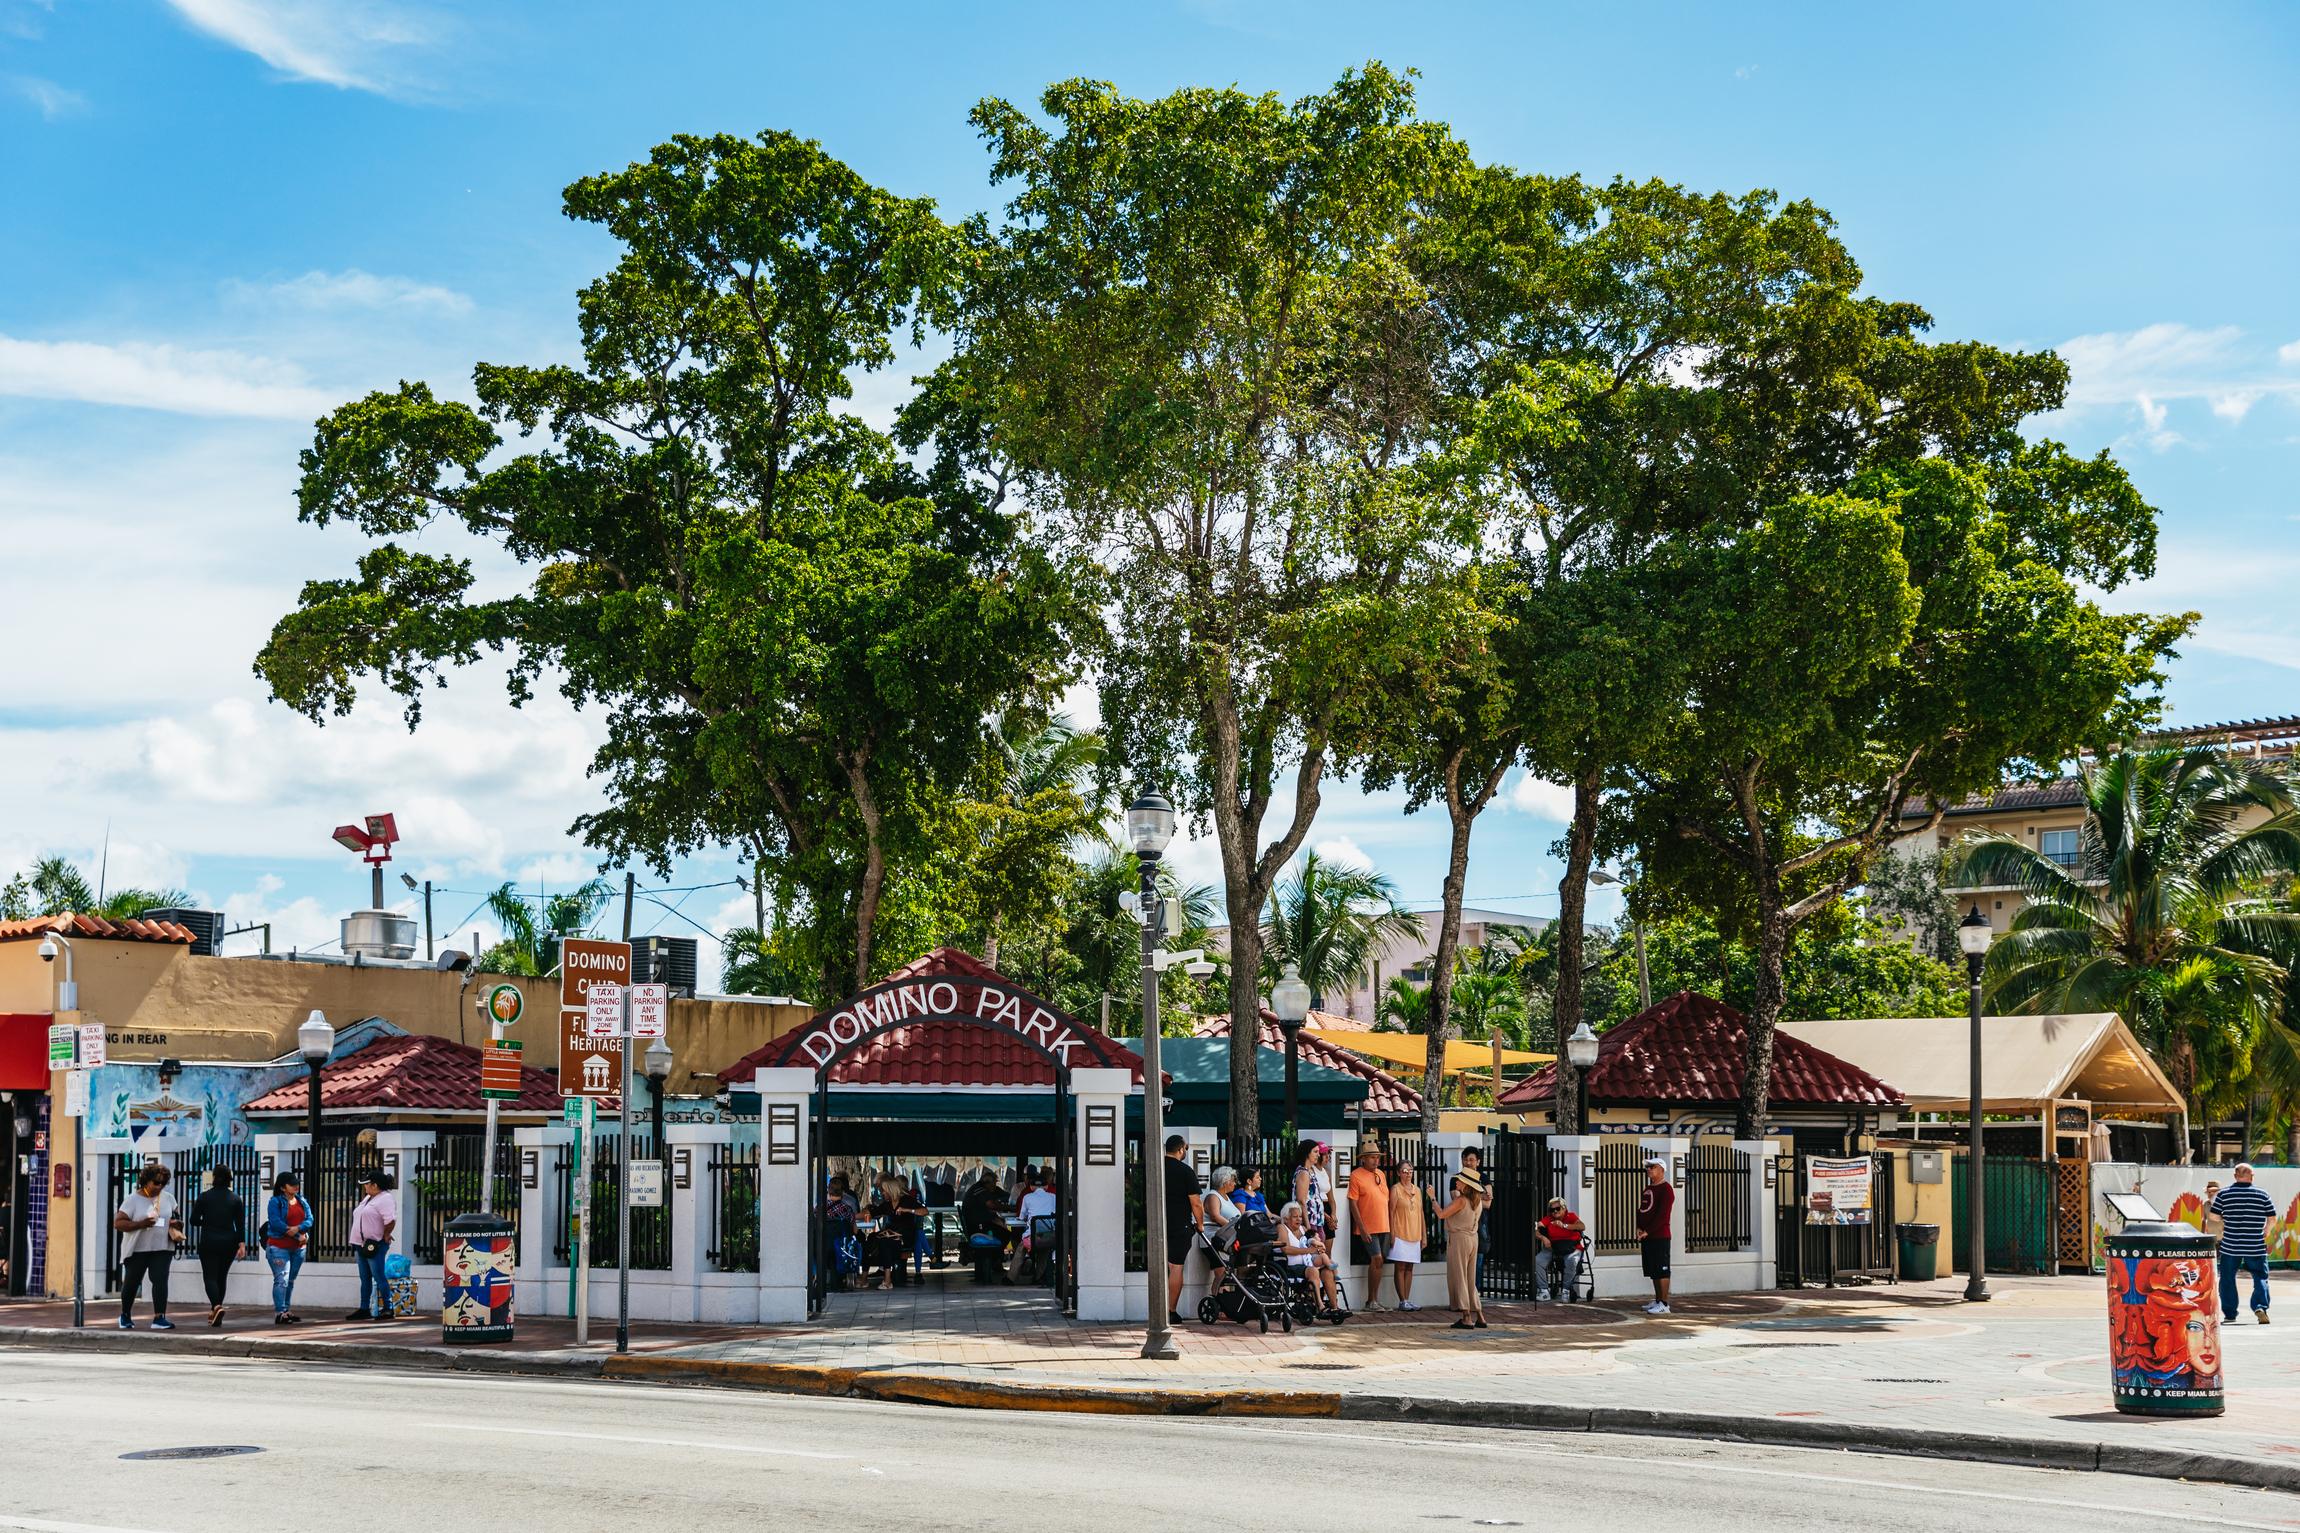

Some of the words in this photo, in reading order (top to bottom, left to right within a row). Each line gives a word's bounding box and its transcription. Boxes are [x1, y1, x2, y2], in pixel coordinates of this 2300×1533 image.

[569, 951, 626, 972] DOMINO
[596, 988, 615, 996] TAXI
[643, 988, 654, 997] NO
[590, 997, 620, 1006] PARKING
[634, 997, 663, 1005] PARKING
[596, 1007, 614, 1015] ONLY
[641, 1006, 656, 1014] ANY
[640, 1014, 657, 1023] TIME
[800, 982, 958, 1067] DOMINO
[975, 986, 1086, 1067] PARK
[123, 1033, 134, 1044] IN
[137, 1034, 167, 1045] REAR
[570, 1034, 623, 1052] HERITAGE
[569, 1102, 574, 1111] 8
[2157, 1250, 2185, 1258] PLEASE
